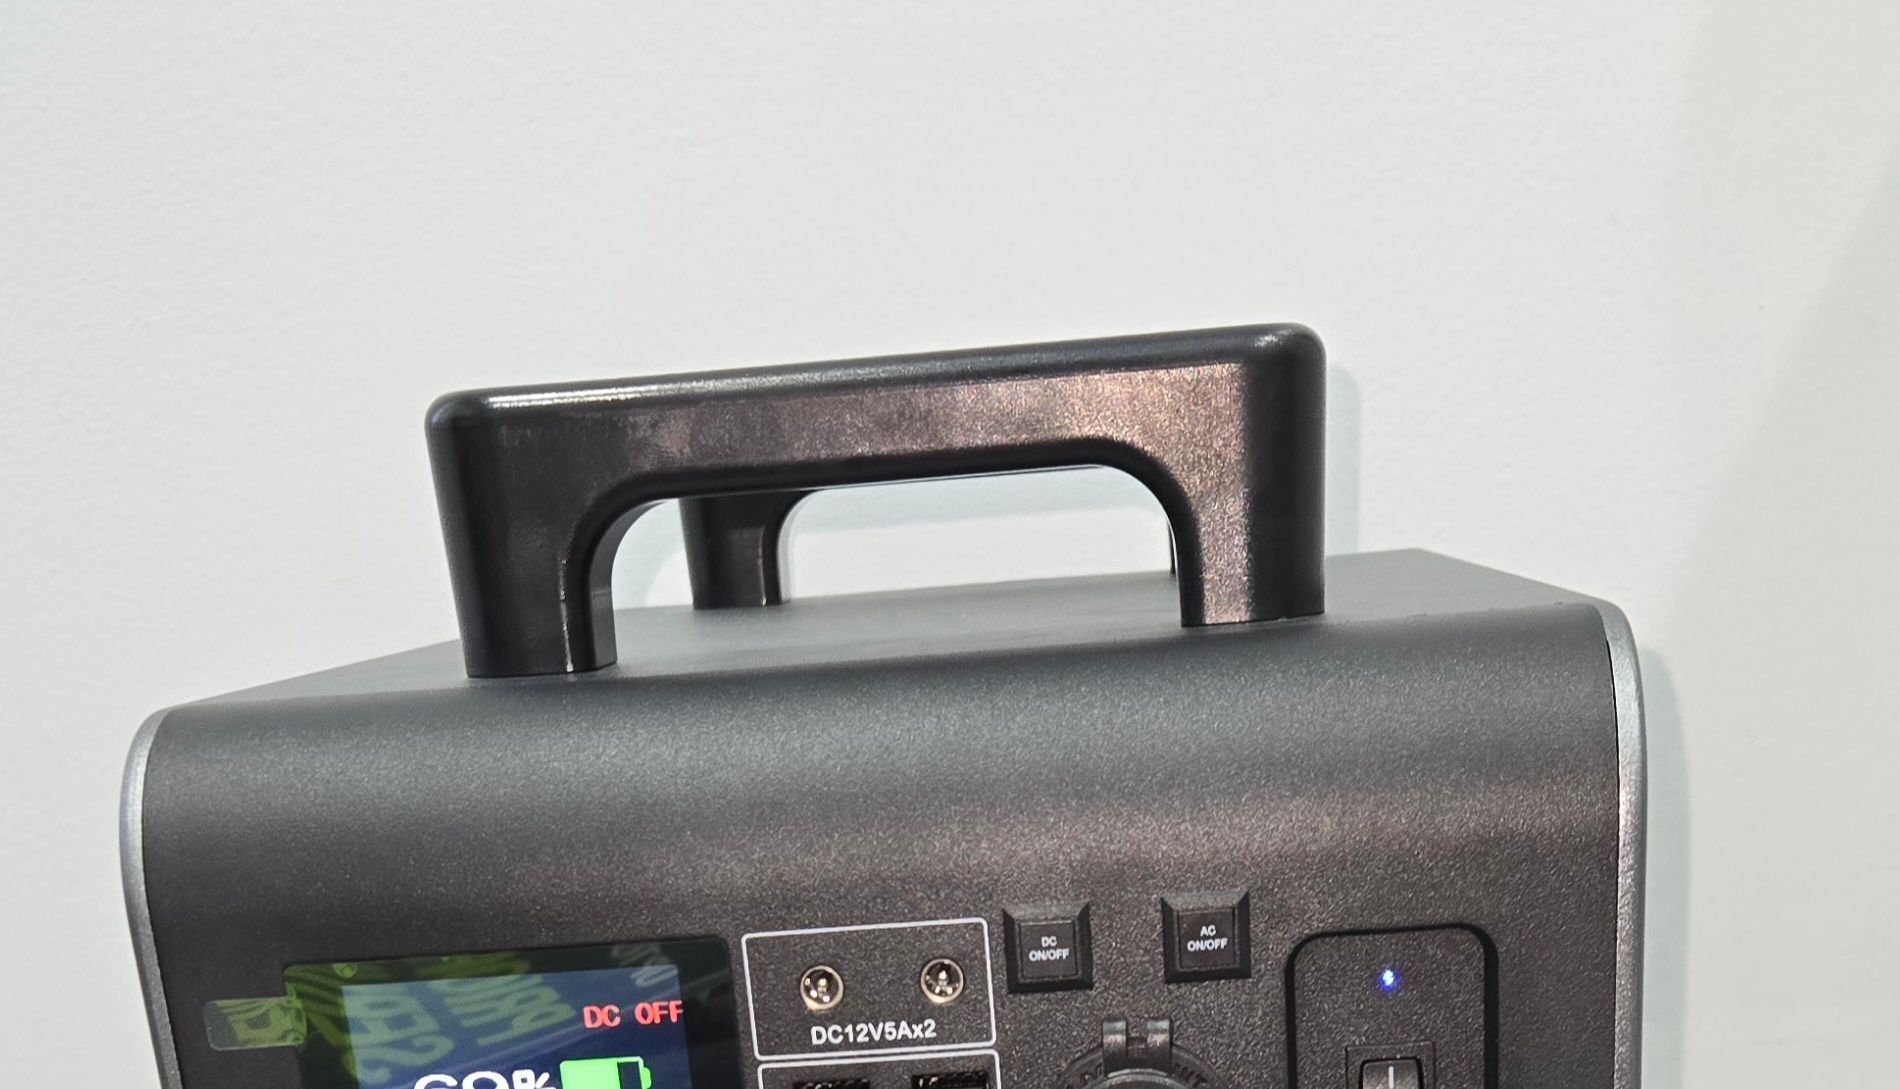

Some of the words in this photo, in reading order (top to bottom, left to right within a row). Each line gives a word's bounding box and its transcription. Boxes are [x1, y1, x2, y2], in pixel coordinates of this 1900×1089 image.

[1199, 925, 1217, 937] AC
[1040, 935, 1058, 948] DC
[1186, 937, 1228, 952] ON/OFF
[1028, 947, 1070, 962] ON/OFF
[583, 1005, 621, 1028] DC
[635, 1000, 684, 1026] OFF
[810, 1018, 937, 1045] DC12V5Ax2
